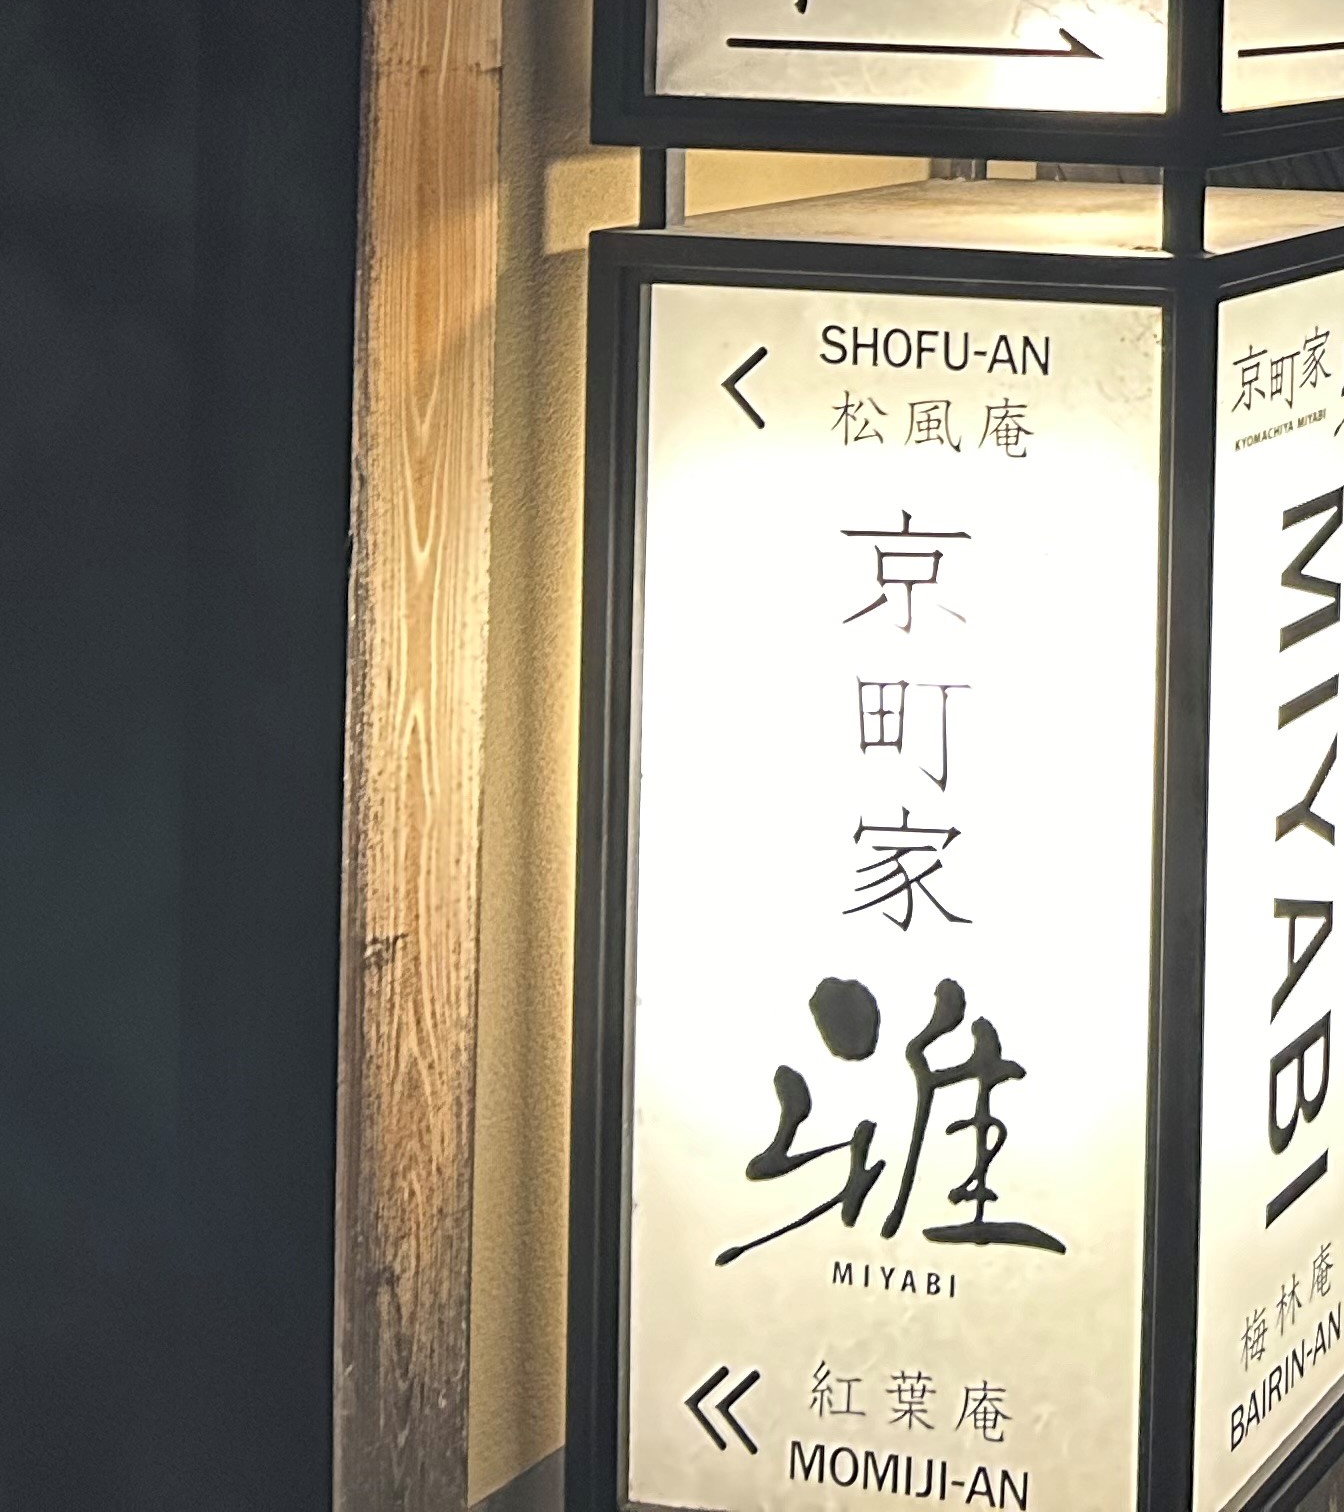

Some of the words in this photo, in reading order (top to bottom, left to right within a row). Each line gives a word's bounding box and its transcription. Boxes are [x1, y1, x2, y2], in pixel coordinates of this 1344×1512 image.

[819, 324, 1051, 376] SHOFU-AN
[1231, 325, 1331, 413] 京町家
[831, 390, 1034, 458] 松風庵
[1234, 421, 1294, 451] KYOMACHIYA
[1296, 408, 1327, 429] MIYABI
[840, 509, 973, 932] 京町家
[1265, 484, 1344, 1230] MIYABI
[832, 1261, 957, 1299] MIYABI
[1240, 1241, 1335, 1372] 梅林庵
[809, 1360, 1013, 1443] 紅葉庵
[1230, 1302, 1343, 1453] BAIRIN-AN
[789, 1440, 1029, 1512] MOMIJI-AN
